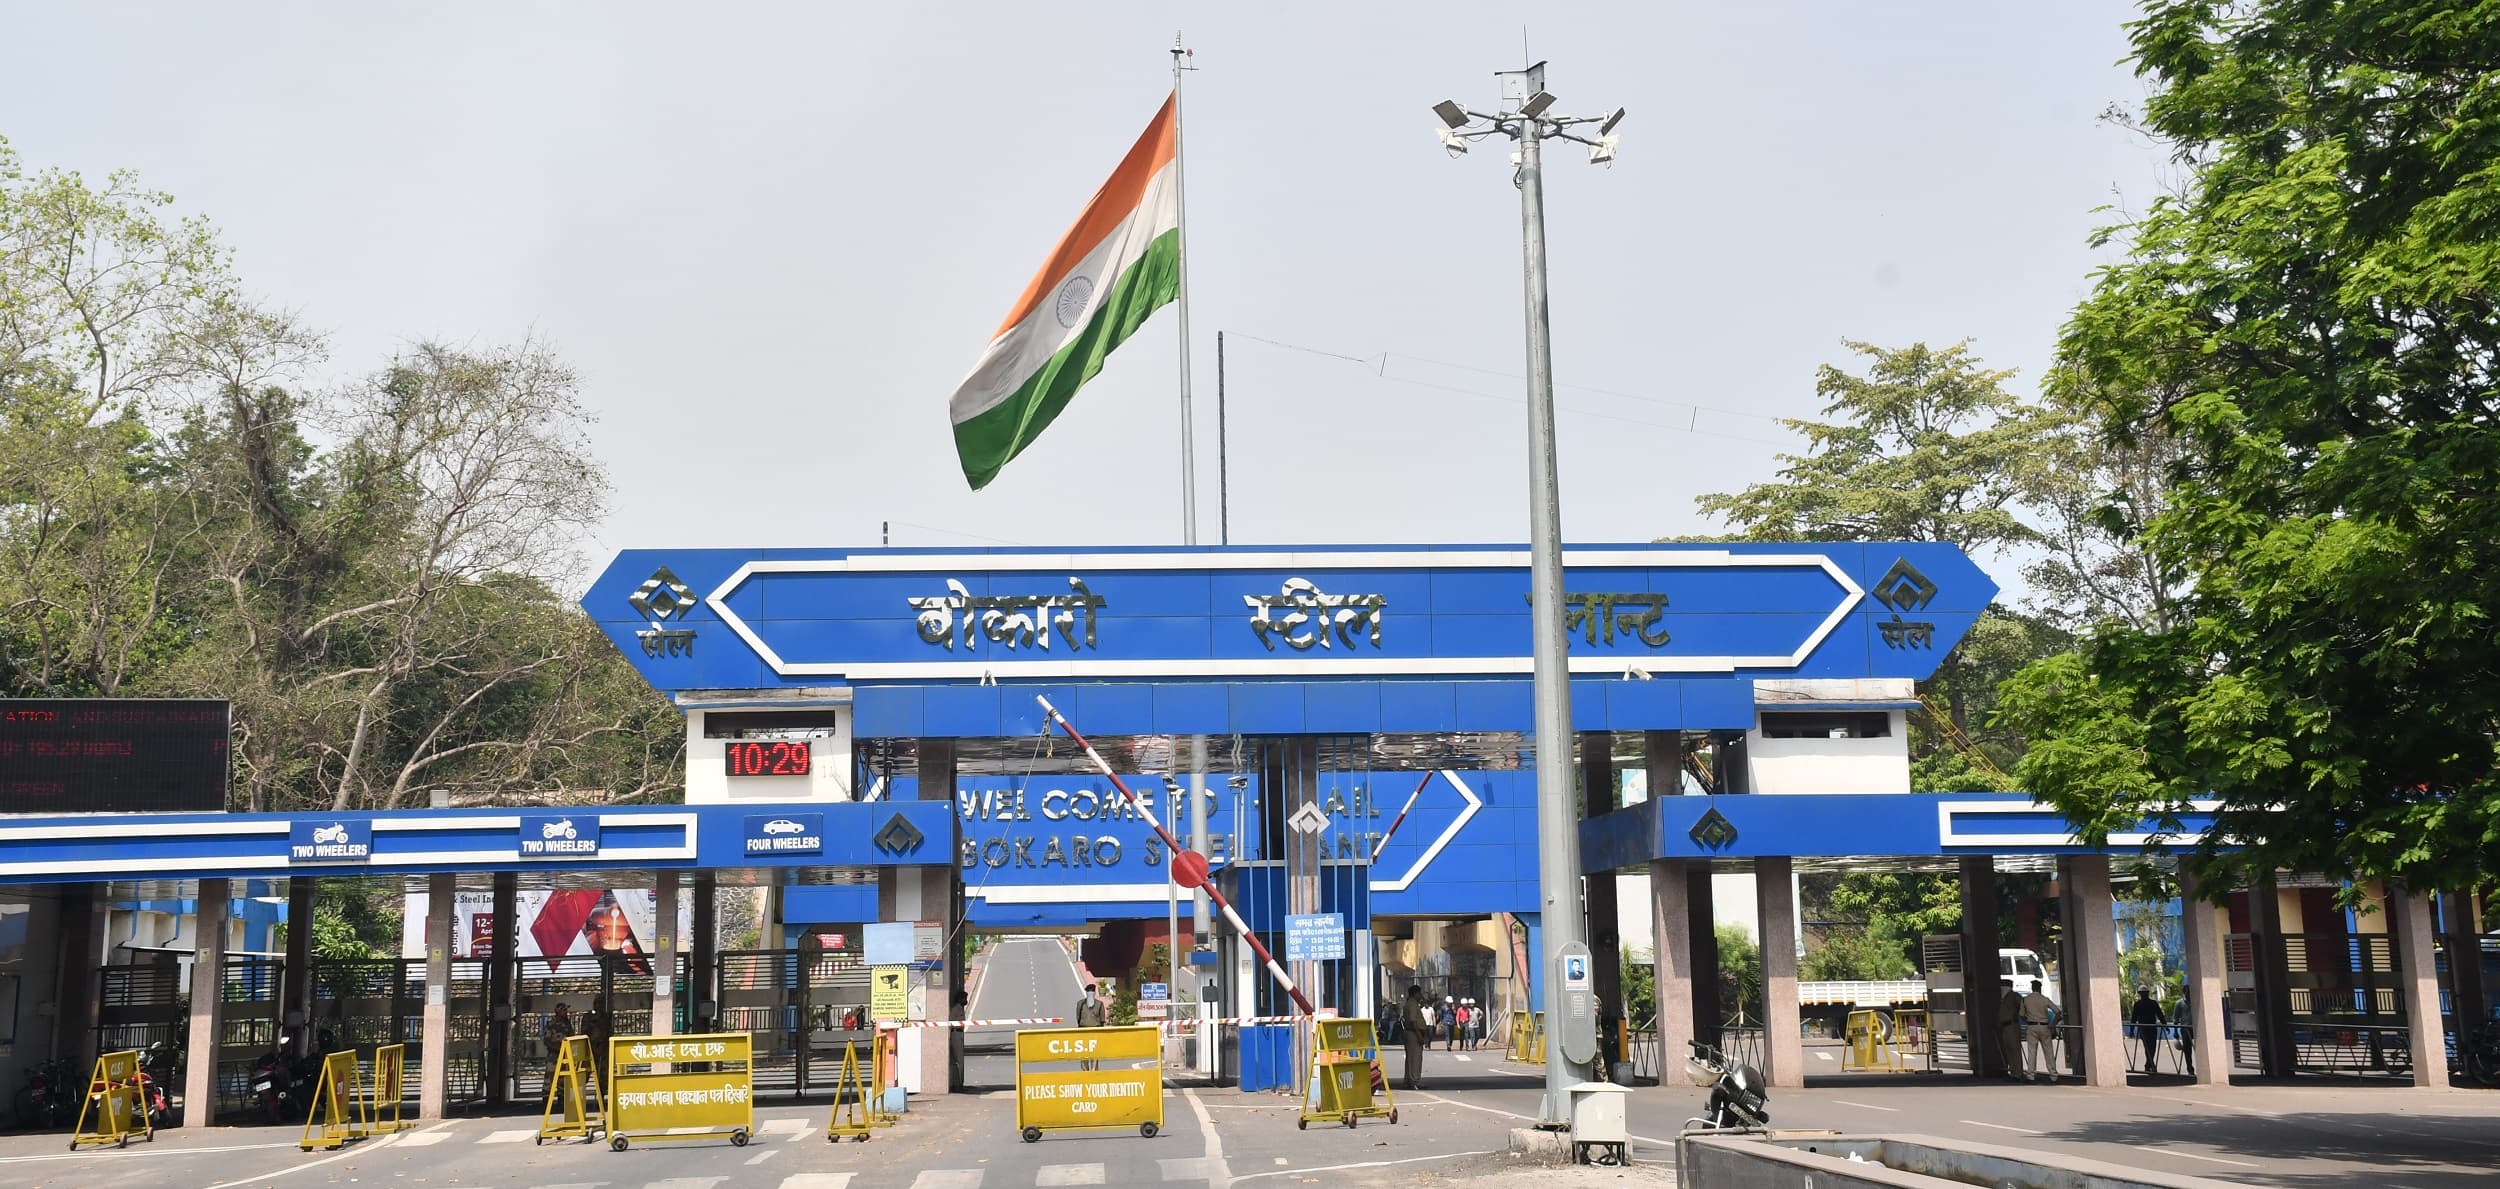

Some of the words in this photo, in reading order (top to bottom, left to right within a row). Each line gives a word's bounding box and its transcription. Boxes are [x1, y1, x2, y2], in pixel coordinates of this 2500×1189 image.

[908, 577, 1107, 652] बोकारो
[1243, 577, 1388, 651] स्टील
[635, 621, 698, 659] सेल
[1877, 613, 1936, 650] सेल
[728, 741, 809, 775] 10:29
[292, 845, 313, 858] TWO
[316, 844, 368, 857] WHEELERS
[522, 840, 543, 853] TWO
[545, 839, 596, 852] WHEELERS
[747, 838, 771, 850] FOUR
[773, 836, 820, 850] WHEELERS
[960, 834, 1121, 868] BOKARO
[459, 894, 481, 904] Steel
[618, 1092, 647, 1110] कृपया
[647, 1090, 673, 1107] अपना
[709, 1088, 724, 1104] पत्र
[1025, 1084, 1056, 1100] PLEASE
[1058, 1083, 1083, 1098] SHOW
[1085, 1083, 1108, 1098] YOUR
[1109, 1081, 1145, 1097] IDENTITY
[1071, 1101, 1098, 1113] CARD
